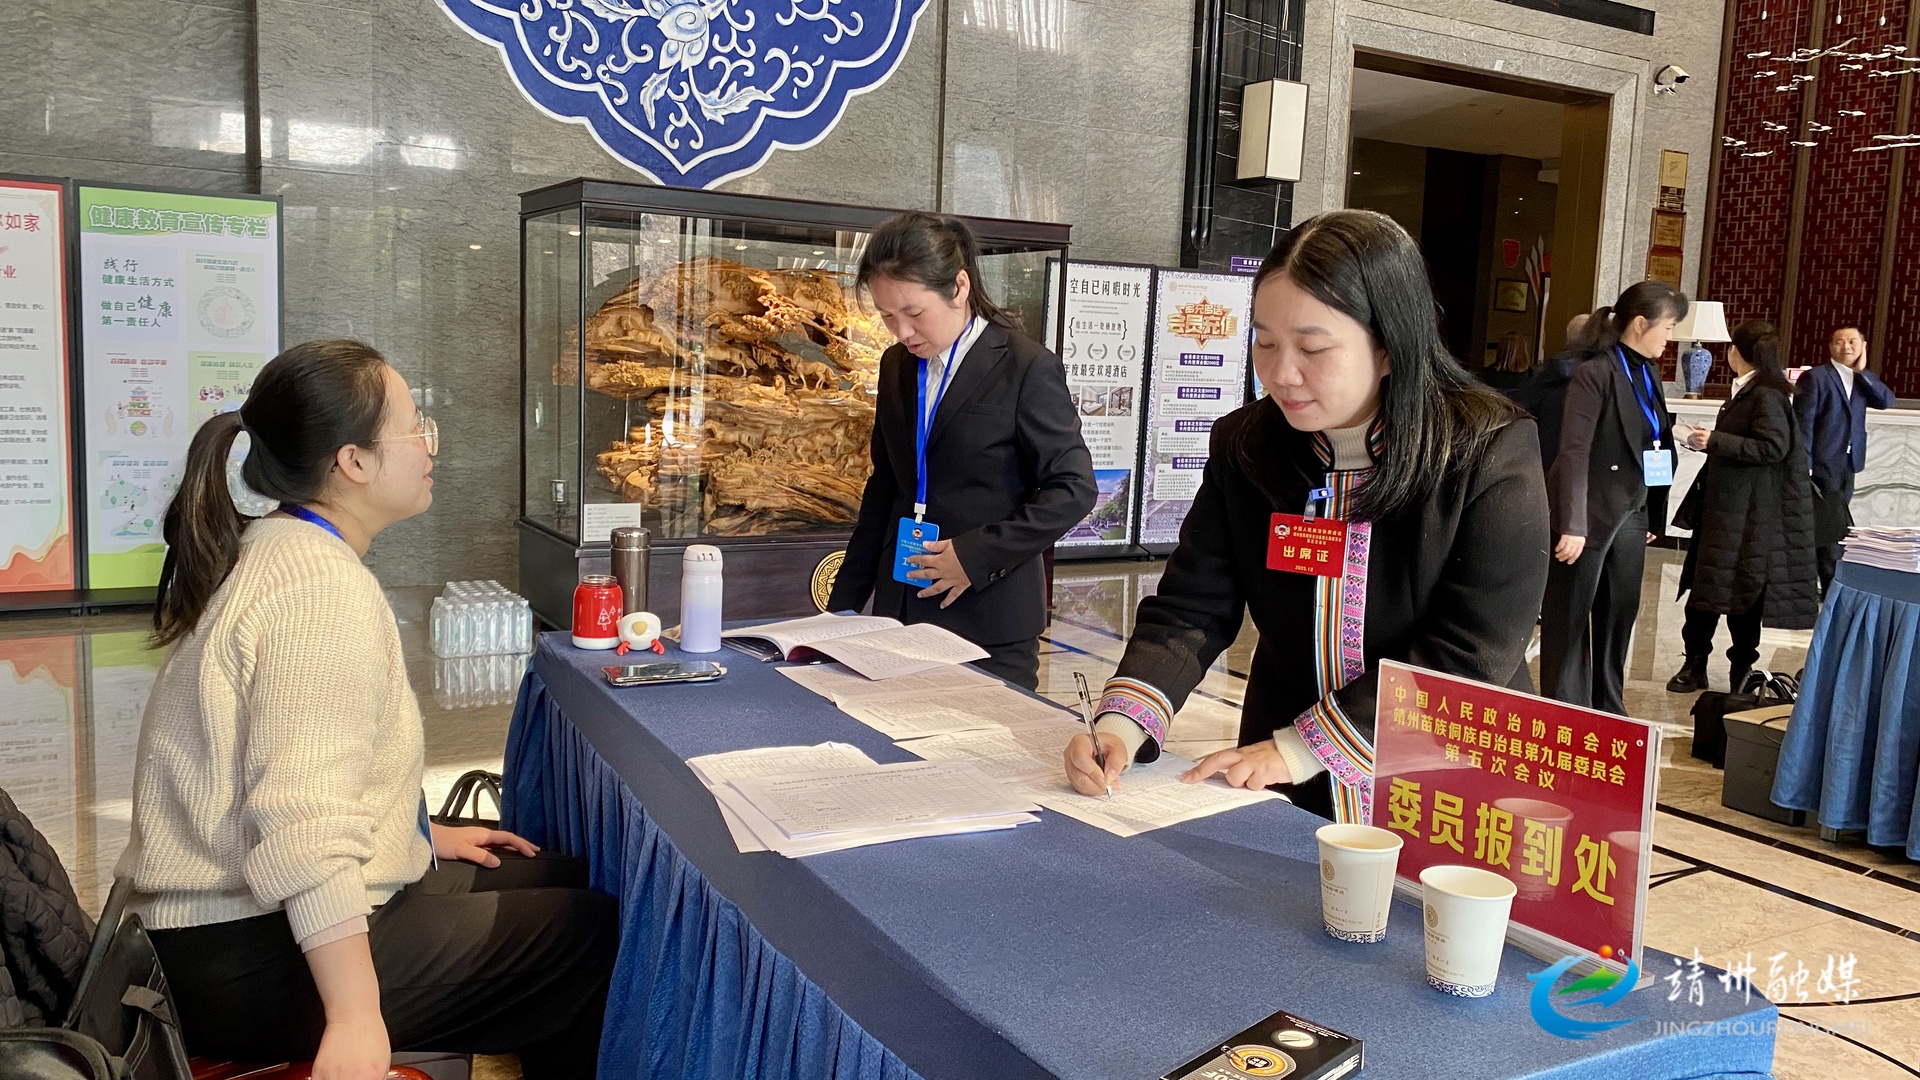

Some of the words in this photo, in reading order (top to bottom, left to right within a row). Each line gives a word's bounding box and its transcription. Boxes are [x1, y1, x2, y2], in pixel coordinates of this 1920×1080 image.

[0, 212, 40, 231] 如家
[89, 205, 269, 238] 健康教育宣传专栏
[0, 265, 17, 278] 业
[104, 257, 138, 272] 践行
[102, 274, 174, 287] 健康生活方式
[101, 294, 172, 318] 做自己健康
[101, 316, 161, 327] 第一责任人
[1167, 313, 1238, 335] 会员充值
[1283, 545, 1329, 562] 出席证
[1395, 685, 1628, 761] 中国人民政治协商会议
[1393, 707, 1626, 786] 靖州苗族侗族自治县第九届委员会
[1444, 743, 1555, 791] 第五次会议
[1387, 776, 1617, 906] 委员报到处
